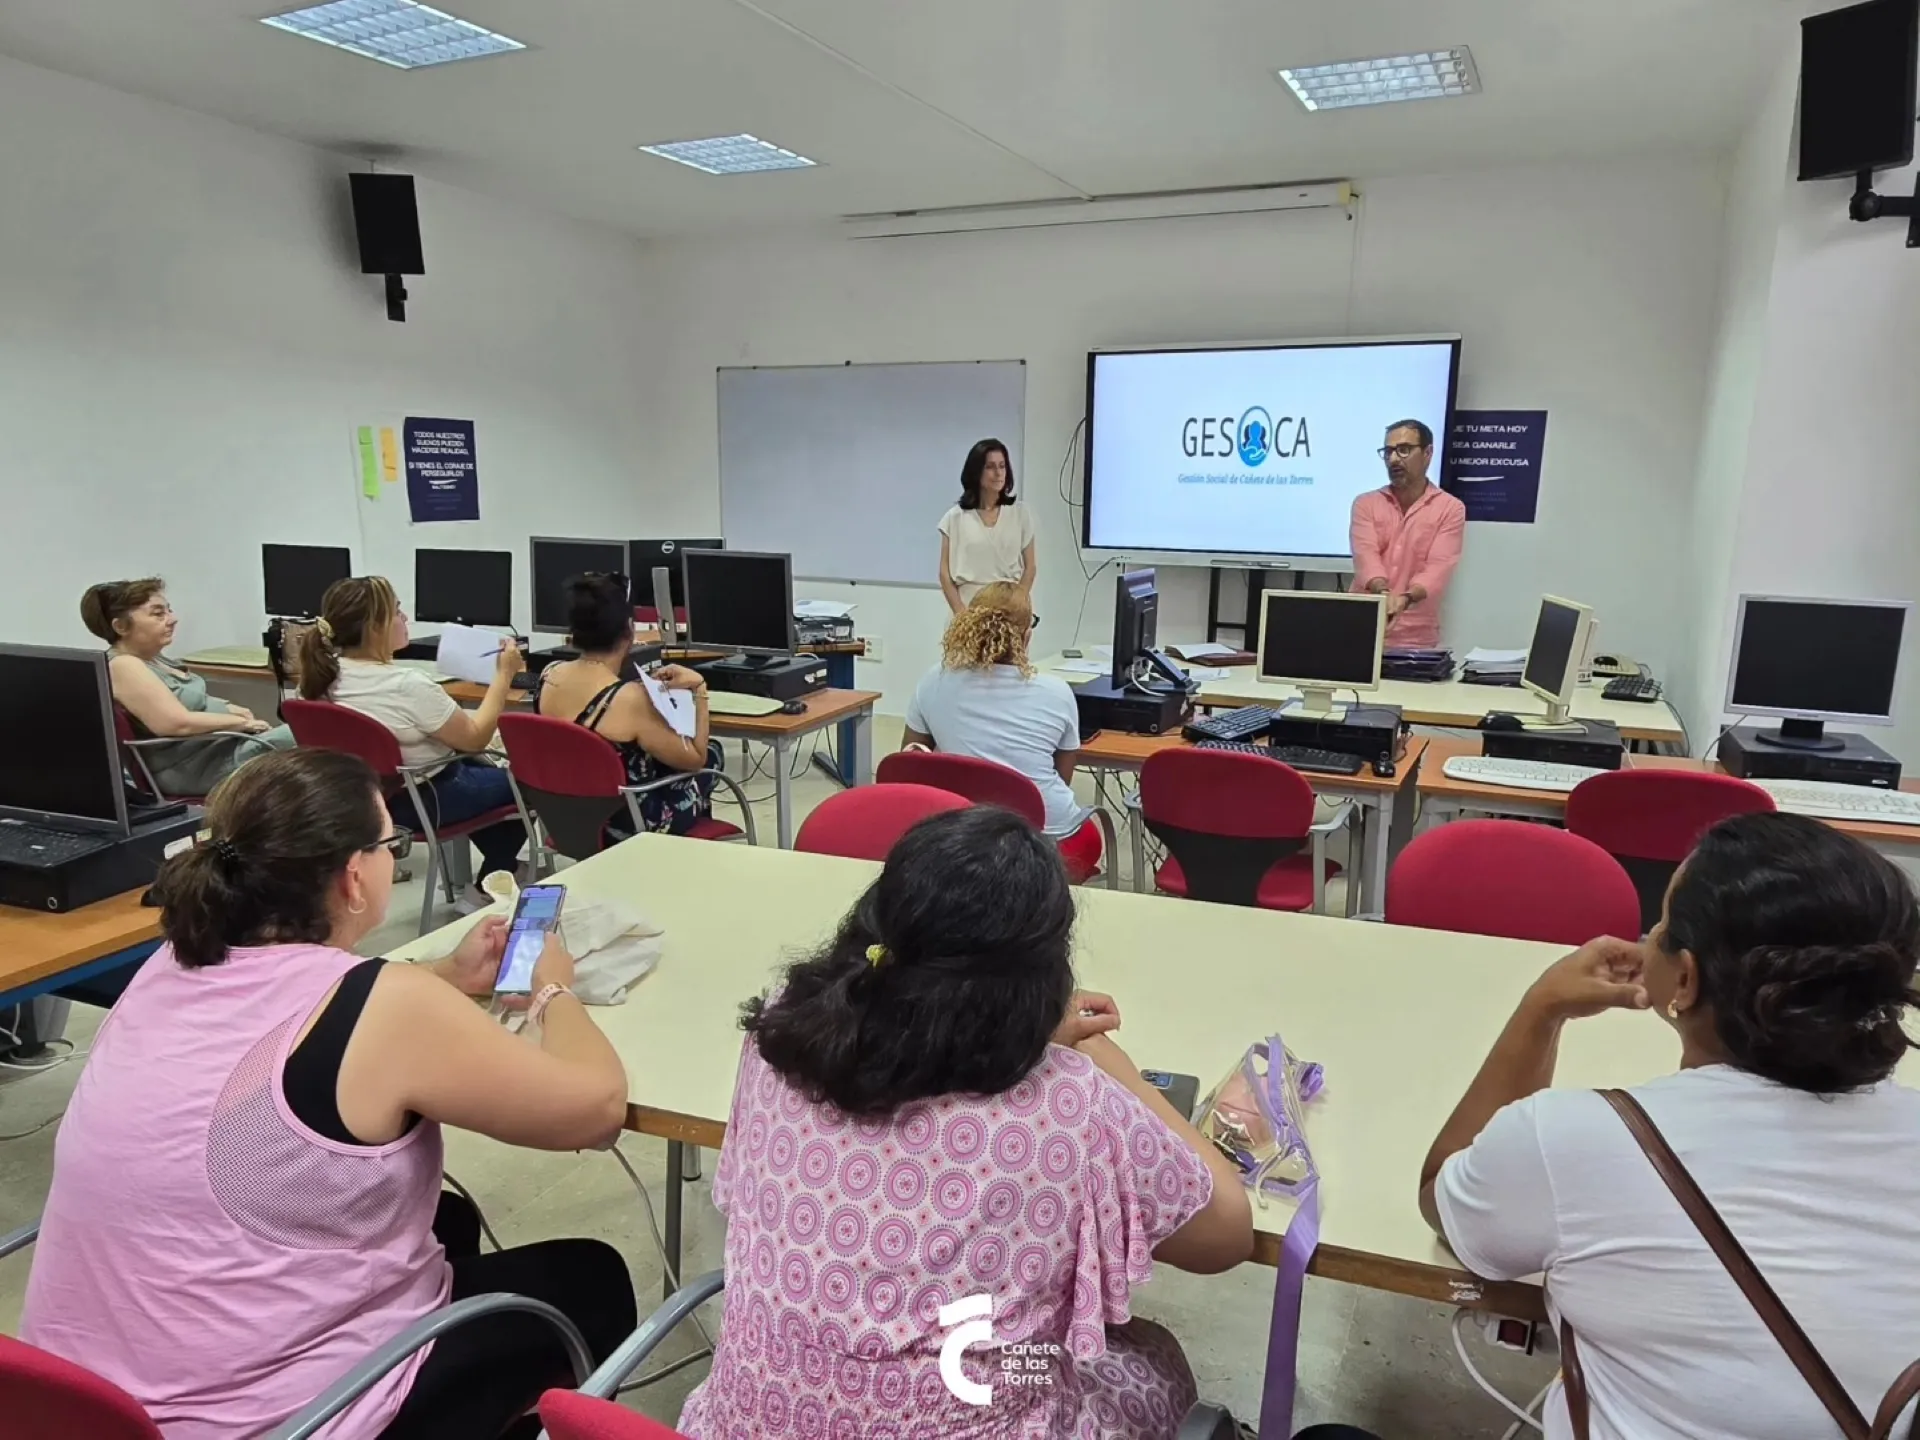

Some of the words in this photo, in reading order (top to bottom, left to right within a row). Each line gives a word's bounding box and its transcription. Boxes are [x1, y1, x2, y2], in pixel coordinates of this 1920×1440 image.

[1466, 425, 1479, 433] TU
[1480, 425, 1505, 433] META
[1507, 425, 1528, 433] HOY
[1452, 441, 1470, 449] SEA
[1472, 441, 1517, 450] GANARLE
[1458, 458, 1489, 466] MEJOR
[1490, 458, 1529, 466] EXCUSA
[1206, 473, 1229, 485] Social
[1229, 474, 1238, 485] de
[1239, 473, 1265, 485] Cañete
[1265, 474, 1276, 485] de
[1276, 474, 1288, 485] las
[1289, 474, 1314, 486] Torres
